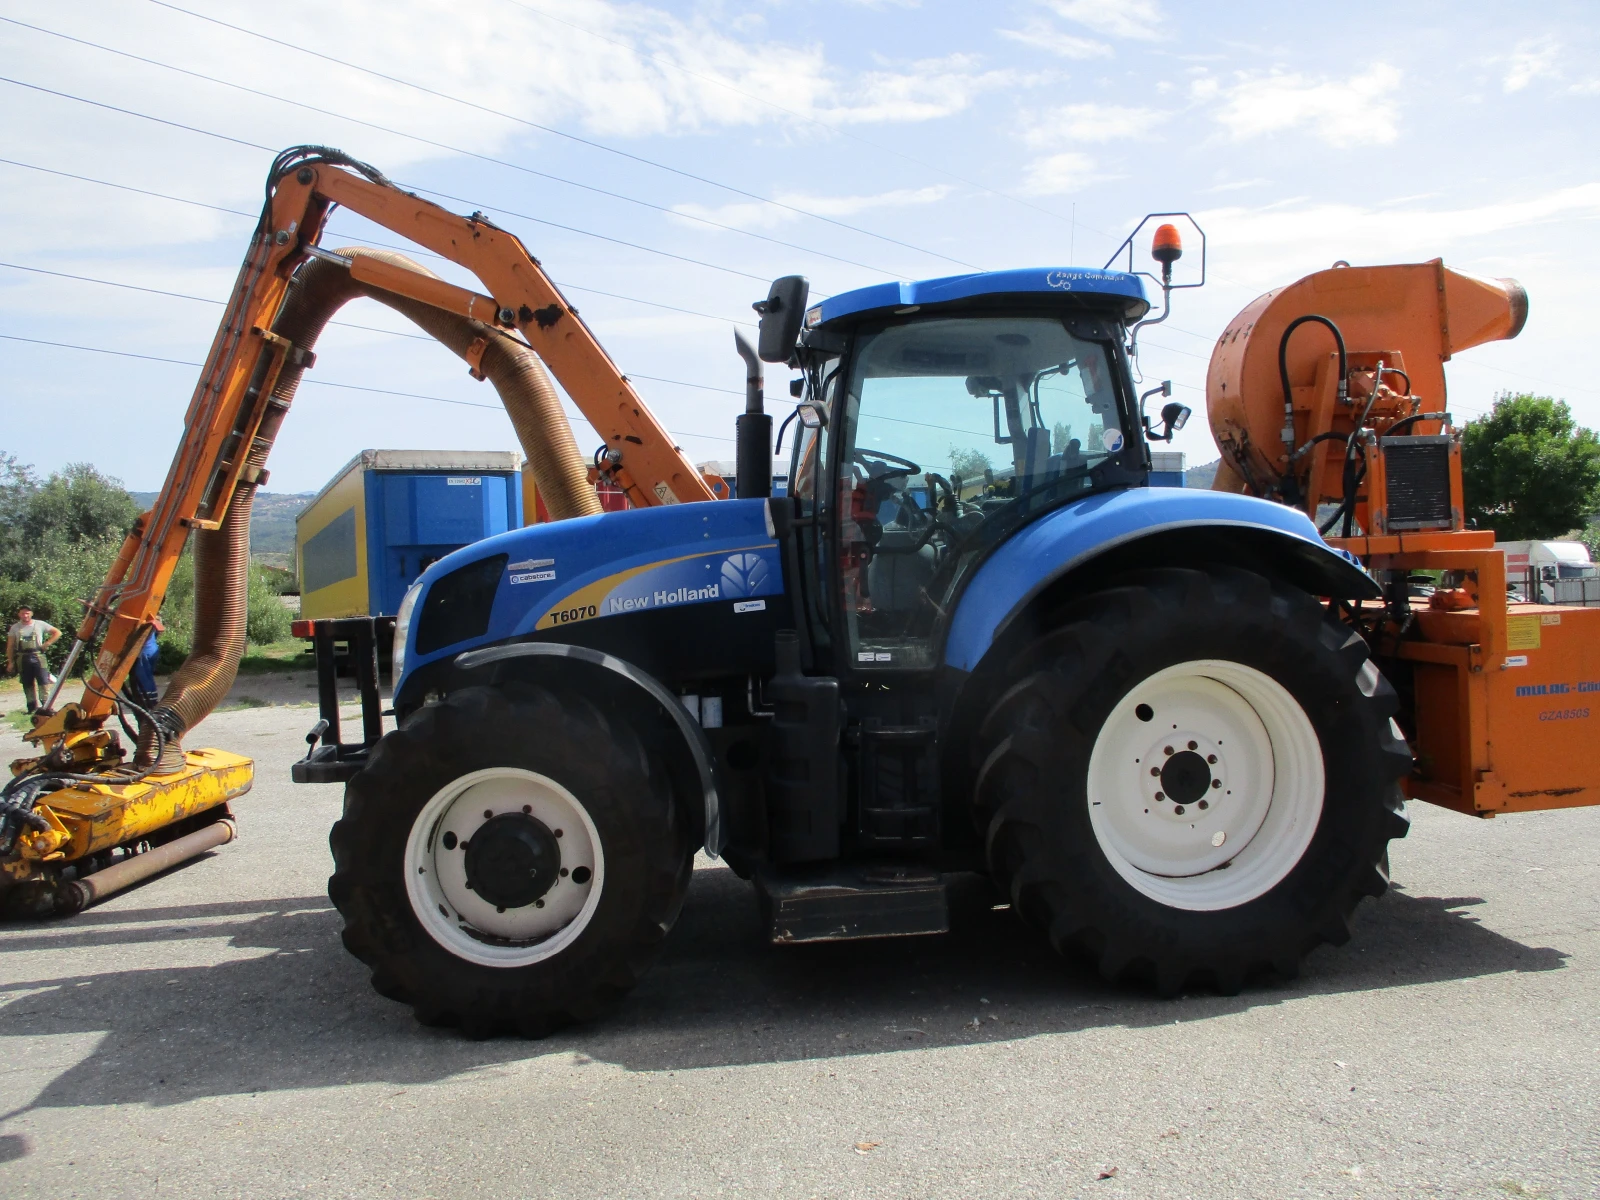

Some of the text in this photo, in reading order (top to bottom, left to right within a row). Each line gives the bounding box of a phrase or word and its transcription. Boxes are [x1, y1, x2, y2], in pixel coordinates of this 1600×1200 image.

[610, 584, 719, 613] New Holland
[550, 605, 597, 624] T6070
